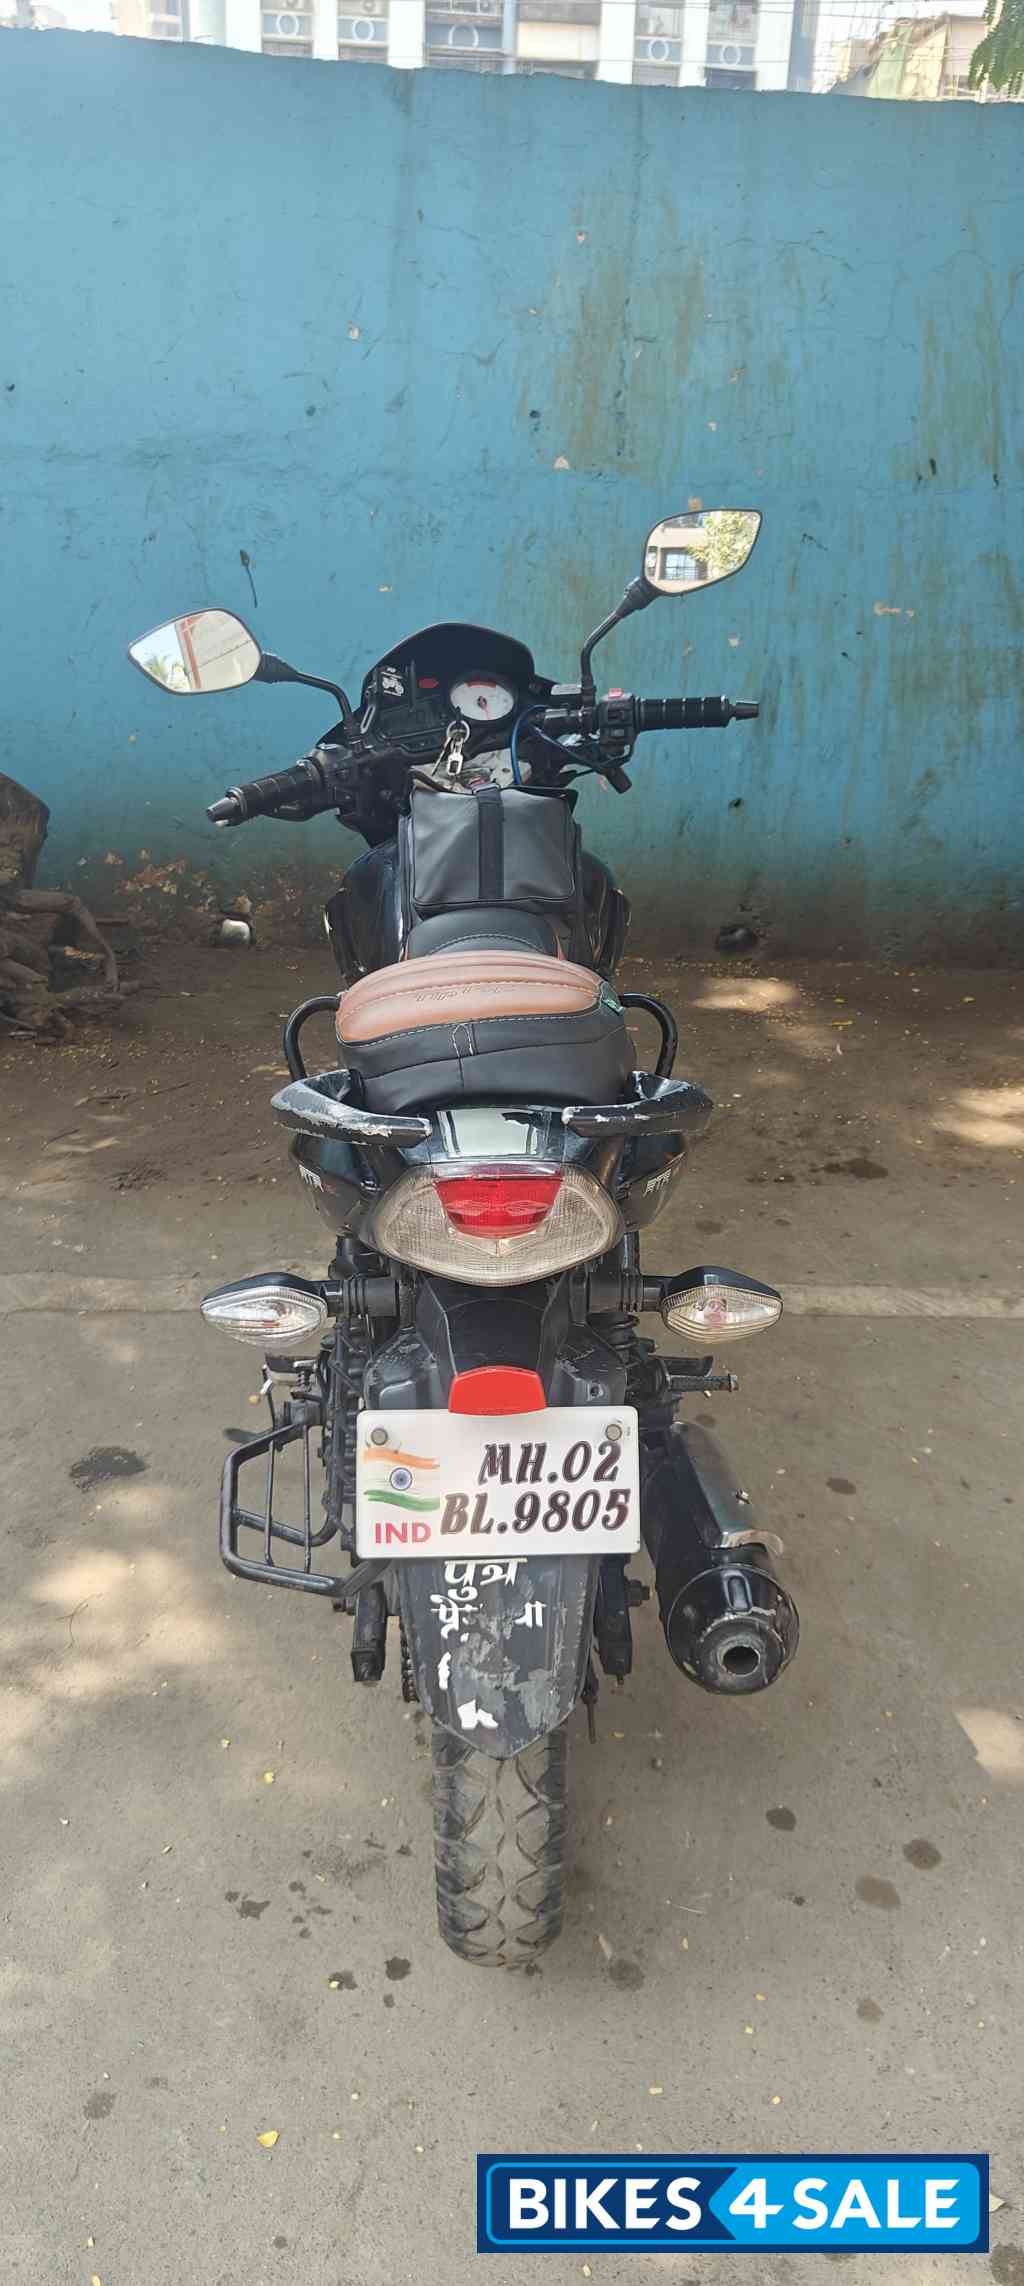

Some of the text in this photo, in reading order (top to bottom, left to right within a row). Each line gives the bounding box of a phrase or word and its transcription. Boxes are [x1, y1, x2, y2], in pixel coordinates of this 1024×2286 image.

[478, 1441, 622, 1485] MH.02
[374, 1521, 431, 1545] IND
[440, 1488, 631, 1536] BL.9805
